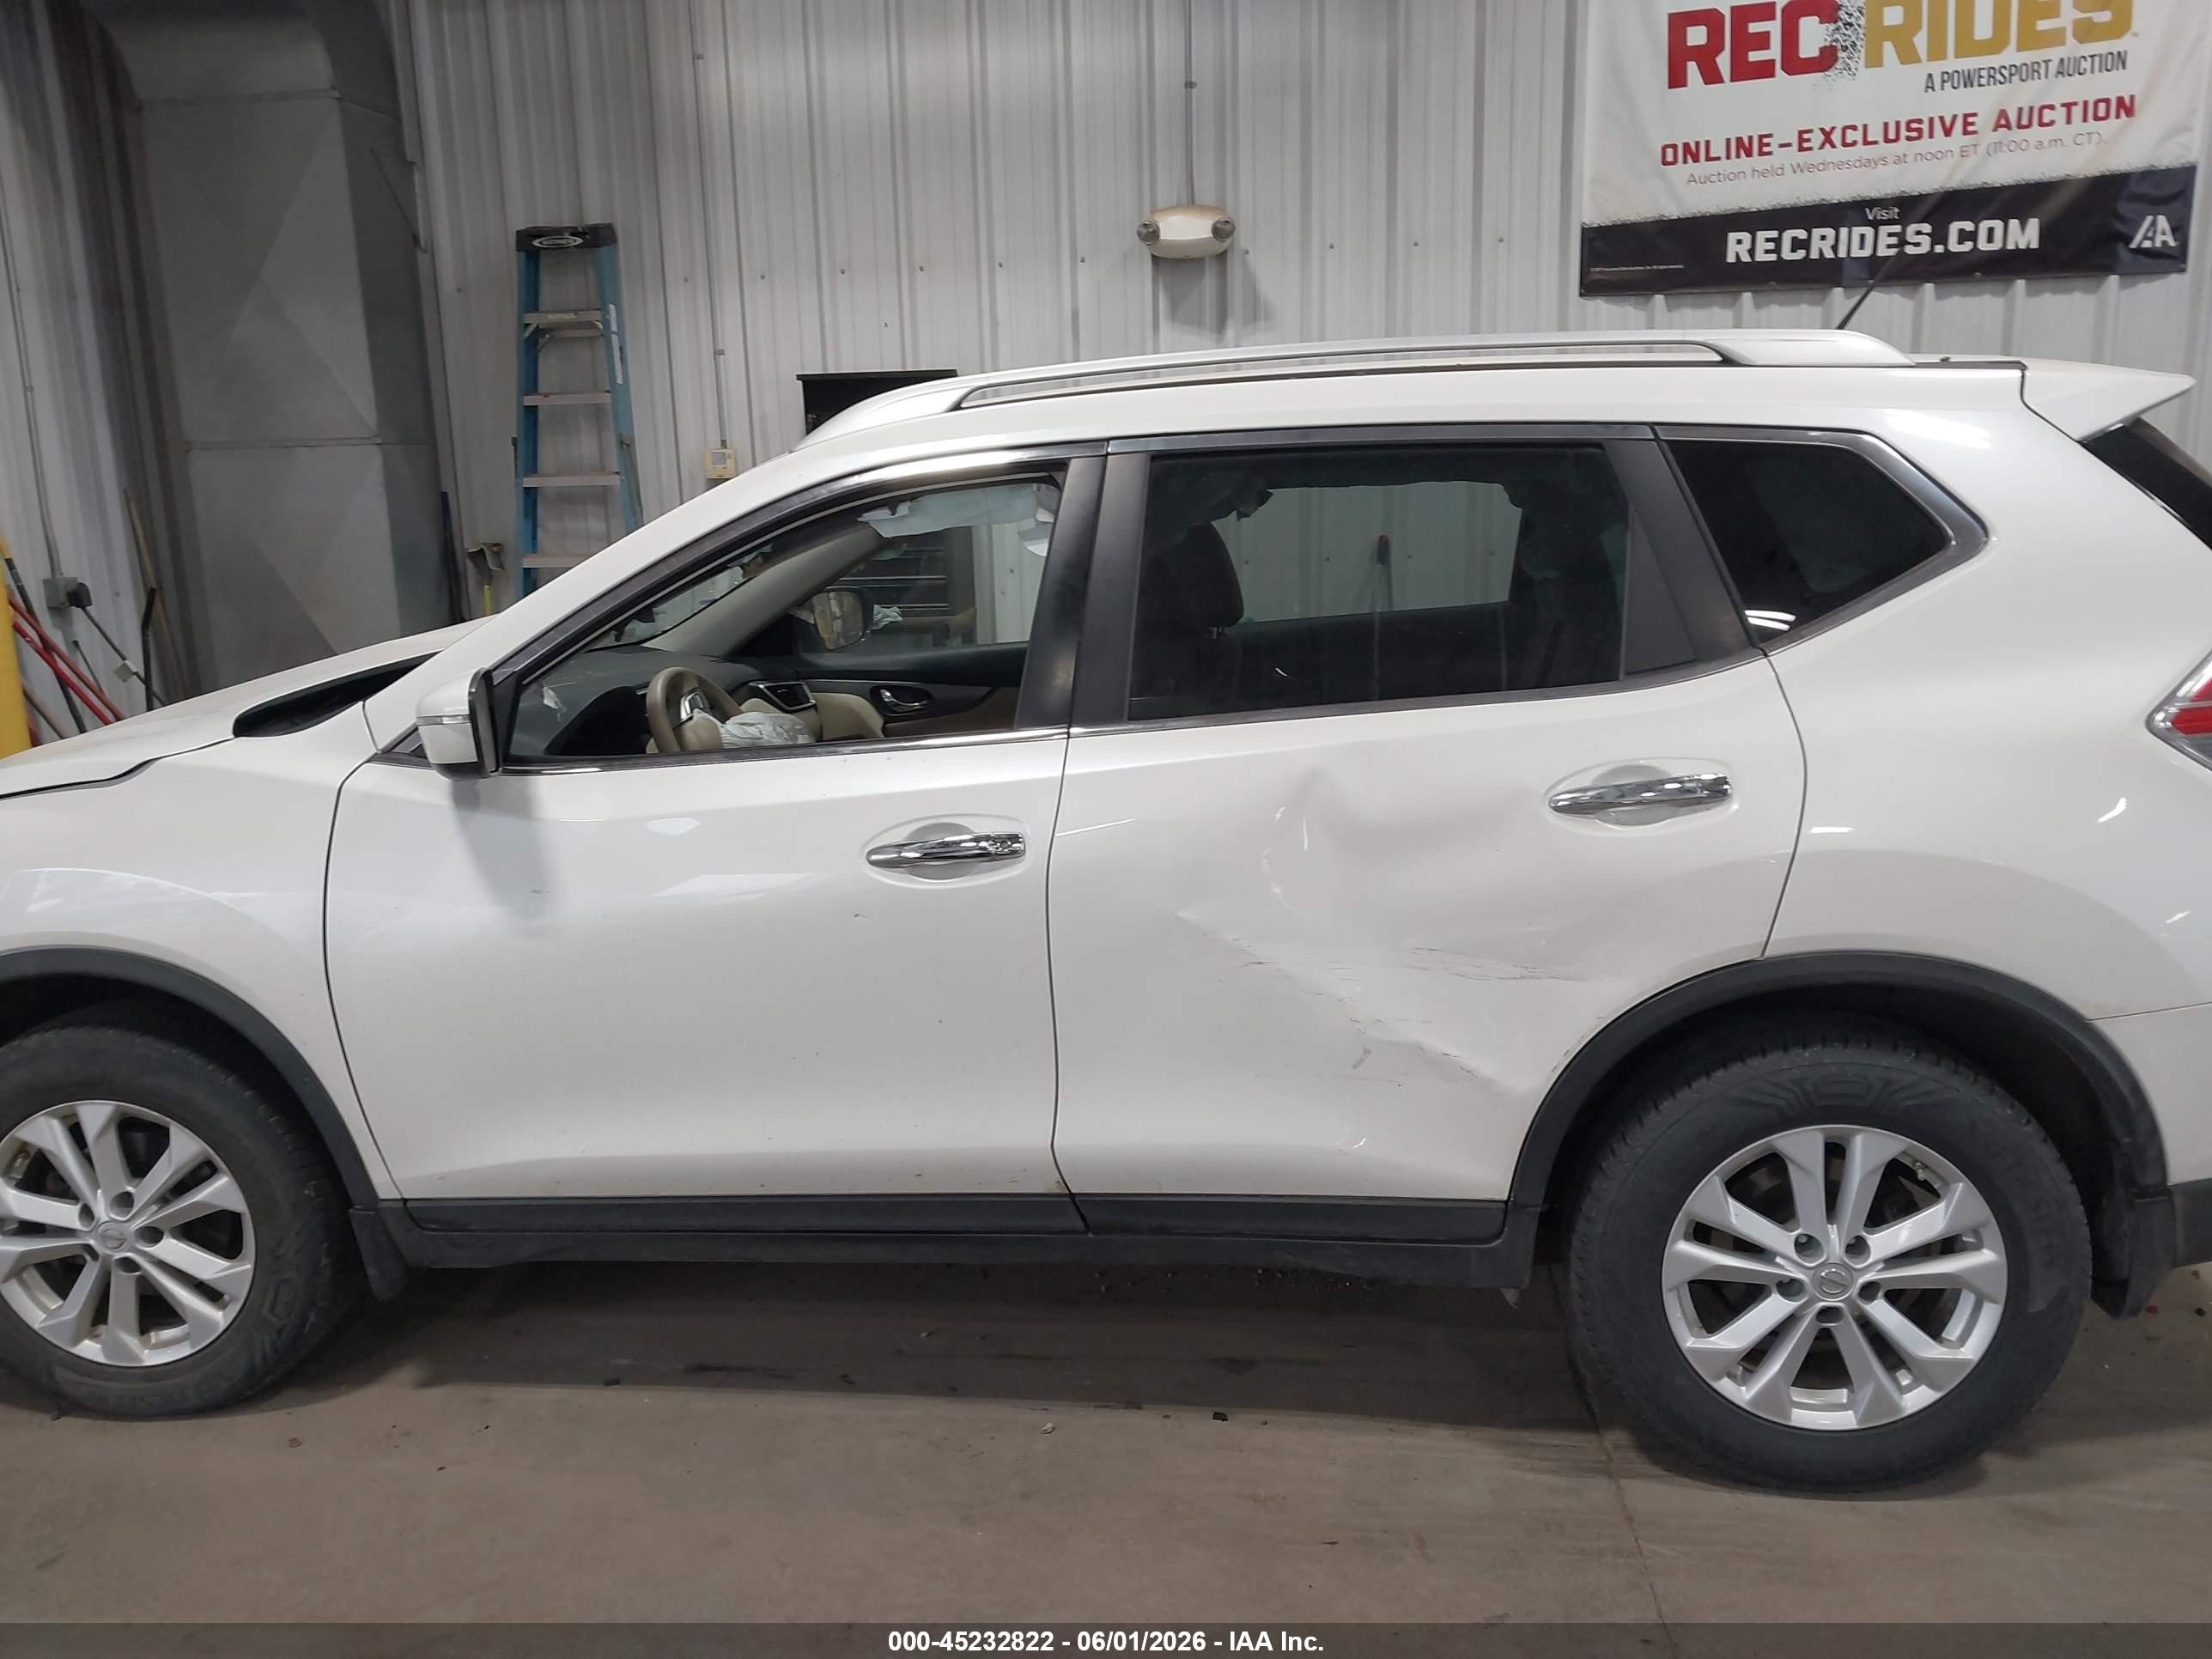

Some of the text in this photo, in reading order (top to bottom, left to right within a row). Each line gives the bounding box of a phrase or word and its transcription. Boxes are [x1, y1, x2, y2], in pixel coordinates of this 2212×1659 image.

[1668, 0, 1839, 89] REC
[1923, 50, 2128, 93] A POWERSPORT AUCTION
[1661, 94, 2136, 167] ONLINE-EXCLUSIVE AUCTION
[1686, 170, 1747, 185] Auction
[1751, 164, 1785, 179] held
[1790, 153, 1889, 174] Wednesdays
[1893, 153, 1908, 165] at
[1914, 149, 1954, 163] noon
[1960, 143, 1981, 158] ET
[1865, 207, 1900, 221] Visit
[1725, 217, 2040, 264] RECRIDES.COM
